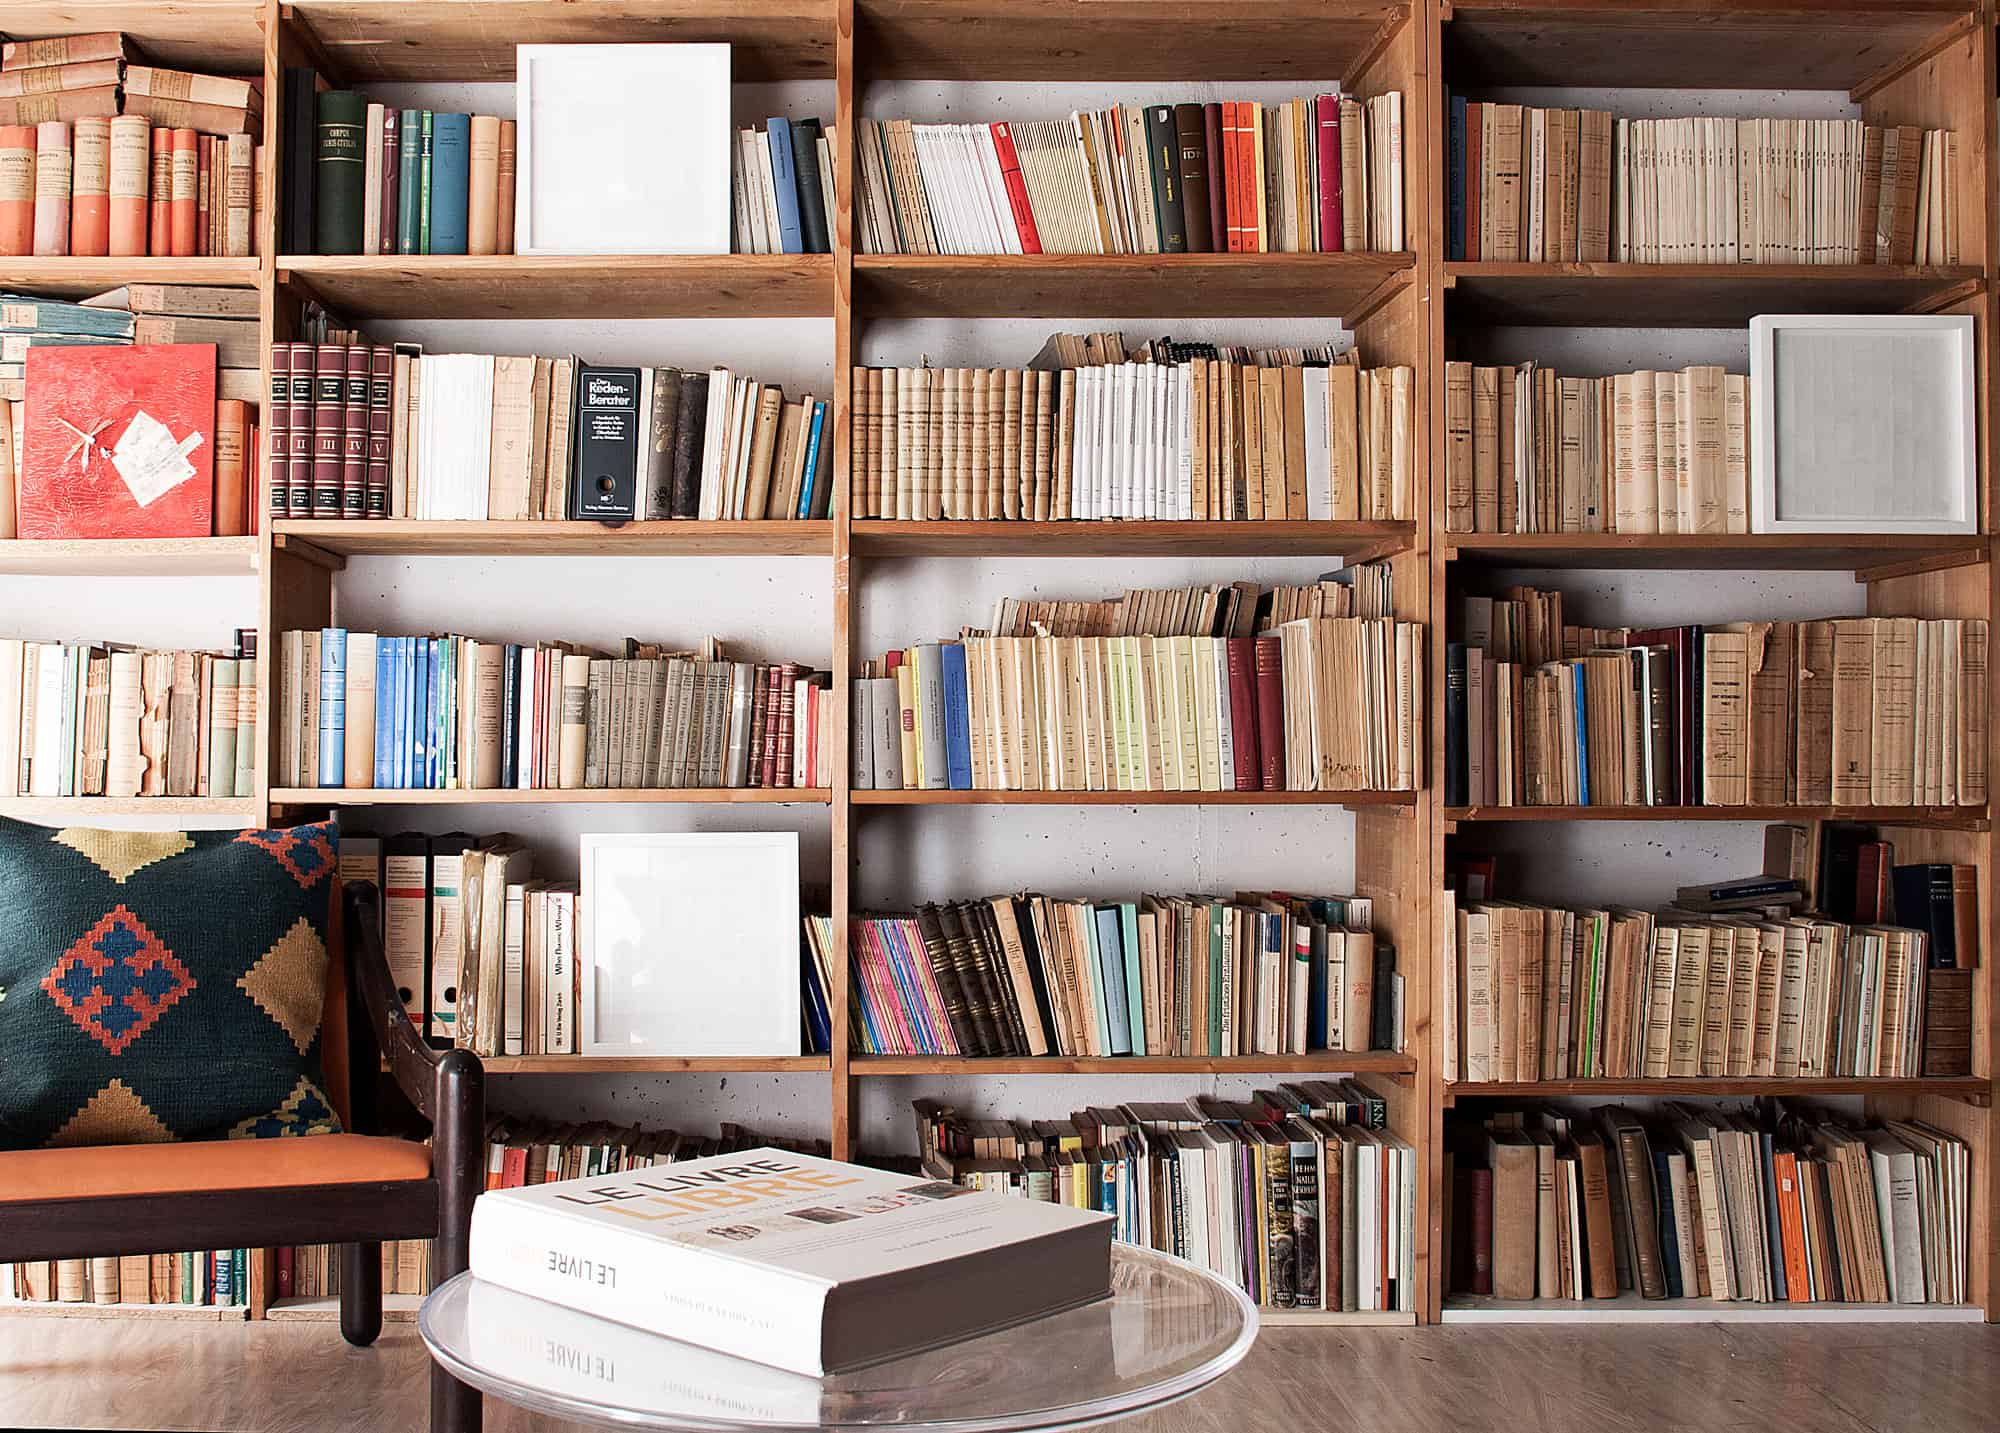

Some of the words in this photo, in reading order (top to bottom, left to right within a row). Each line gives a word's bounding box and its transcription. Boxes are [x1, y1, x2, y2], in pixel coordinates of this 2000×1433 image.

[588, 382, 629, 394] Reden-
[588, 394, 630, 406] Berater
[276, 439, 282, 448] I
[297, 439, 306, 448] II
[322, 439, 336, 450] III
[349, 440, 362, 450] IV
[375, 443, 384, 454] V
[554, 1186, 643, 1205] LE
[635, 1159, 800, 1194] LIVRE
[596, 1168, 865, 1221] LIBRE
[548, 1251, 592, 1281] LIVRE
[597, 1264, 616, 1289] LE
